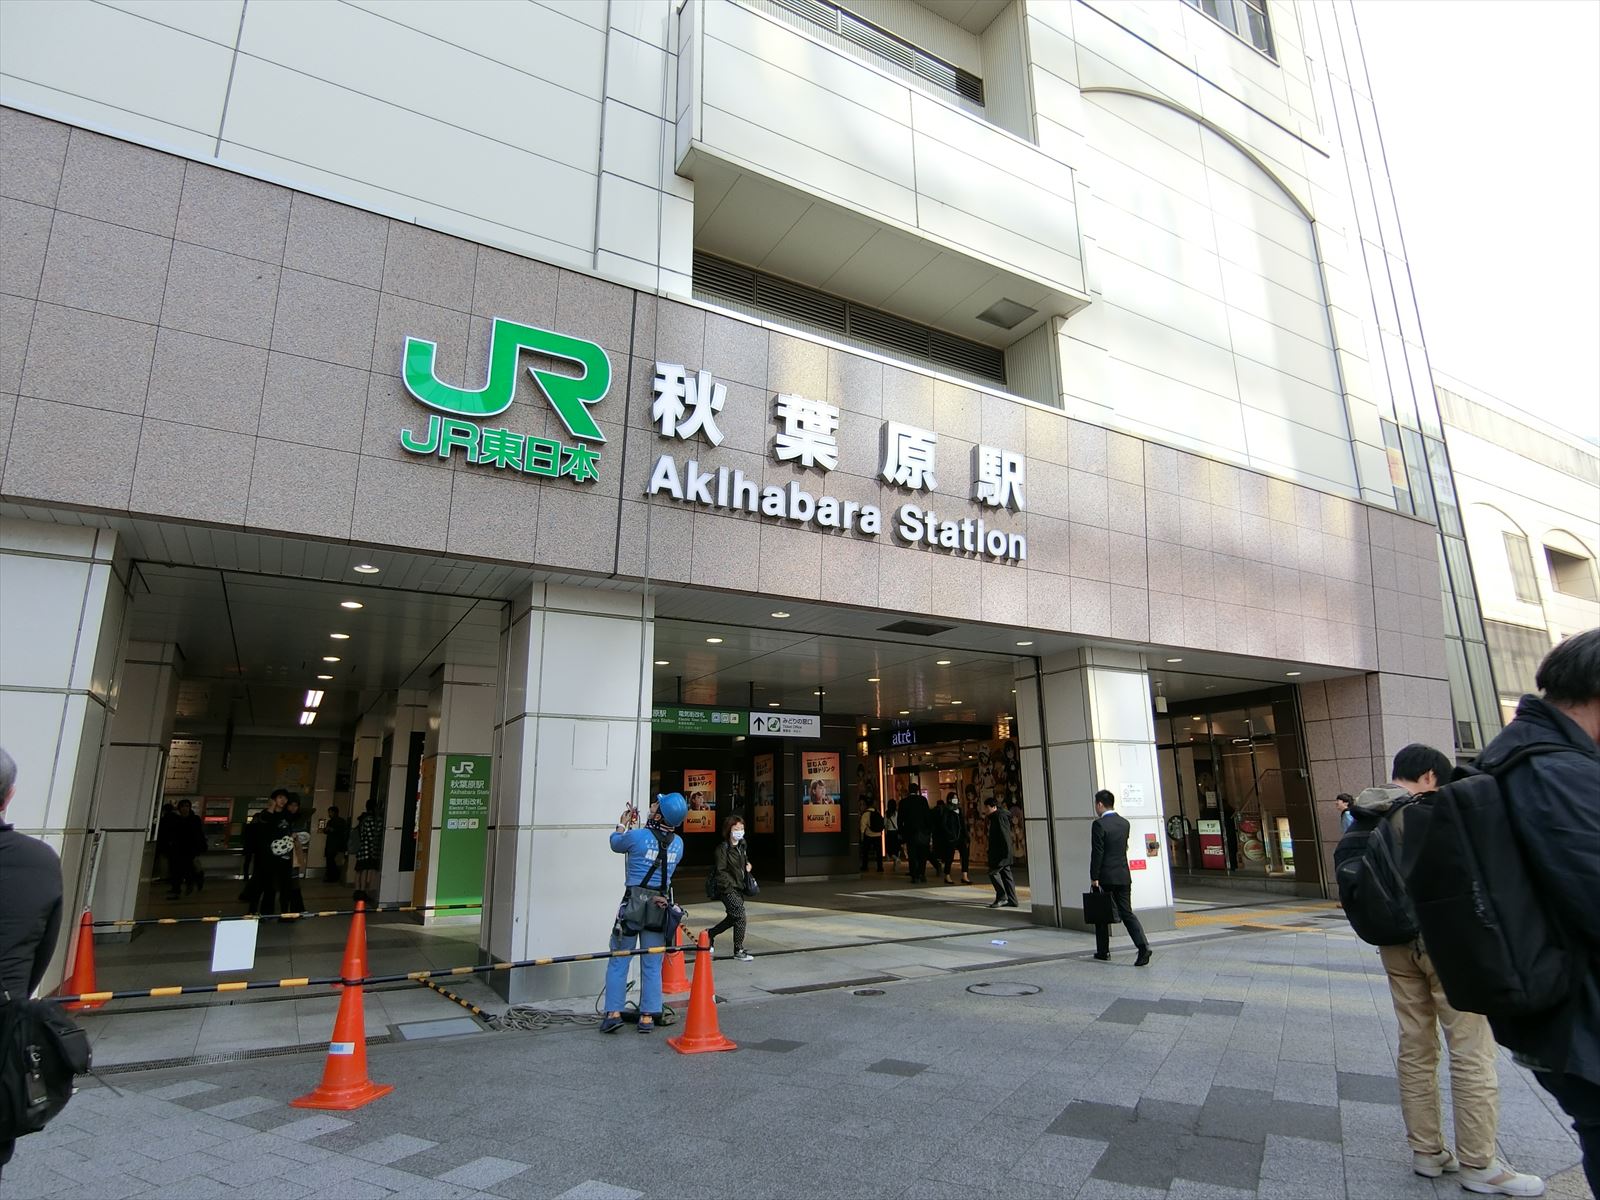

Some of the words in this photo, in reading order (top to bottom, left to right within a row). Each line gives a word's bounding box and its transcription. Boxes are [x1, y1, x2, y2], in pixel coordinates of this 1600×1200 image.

[402, 317, 612, 443] JR
[400, 414, 602, 484] JR東日本
[652, 361, 1026, 513] 秋葉原駅
[646, 454, 882, 537] Akihabara
[896, 503, 1028, 561] Station
[451, 761, 474, 774] JR
